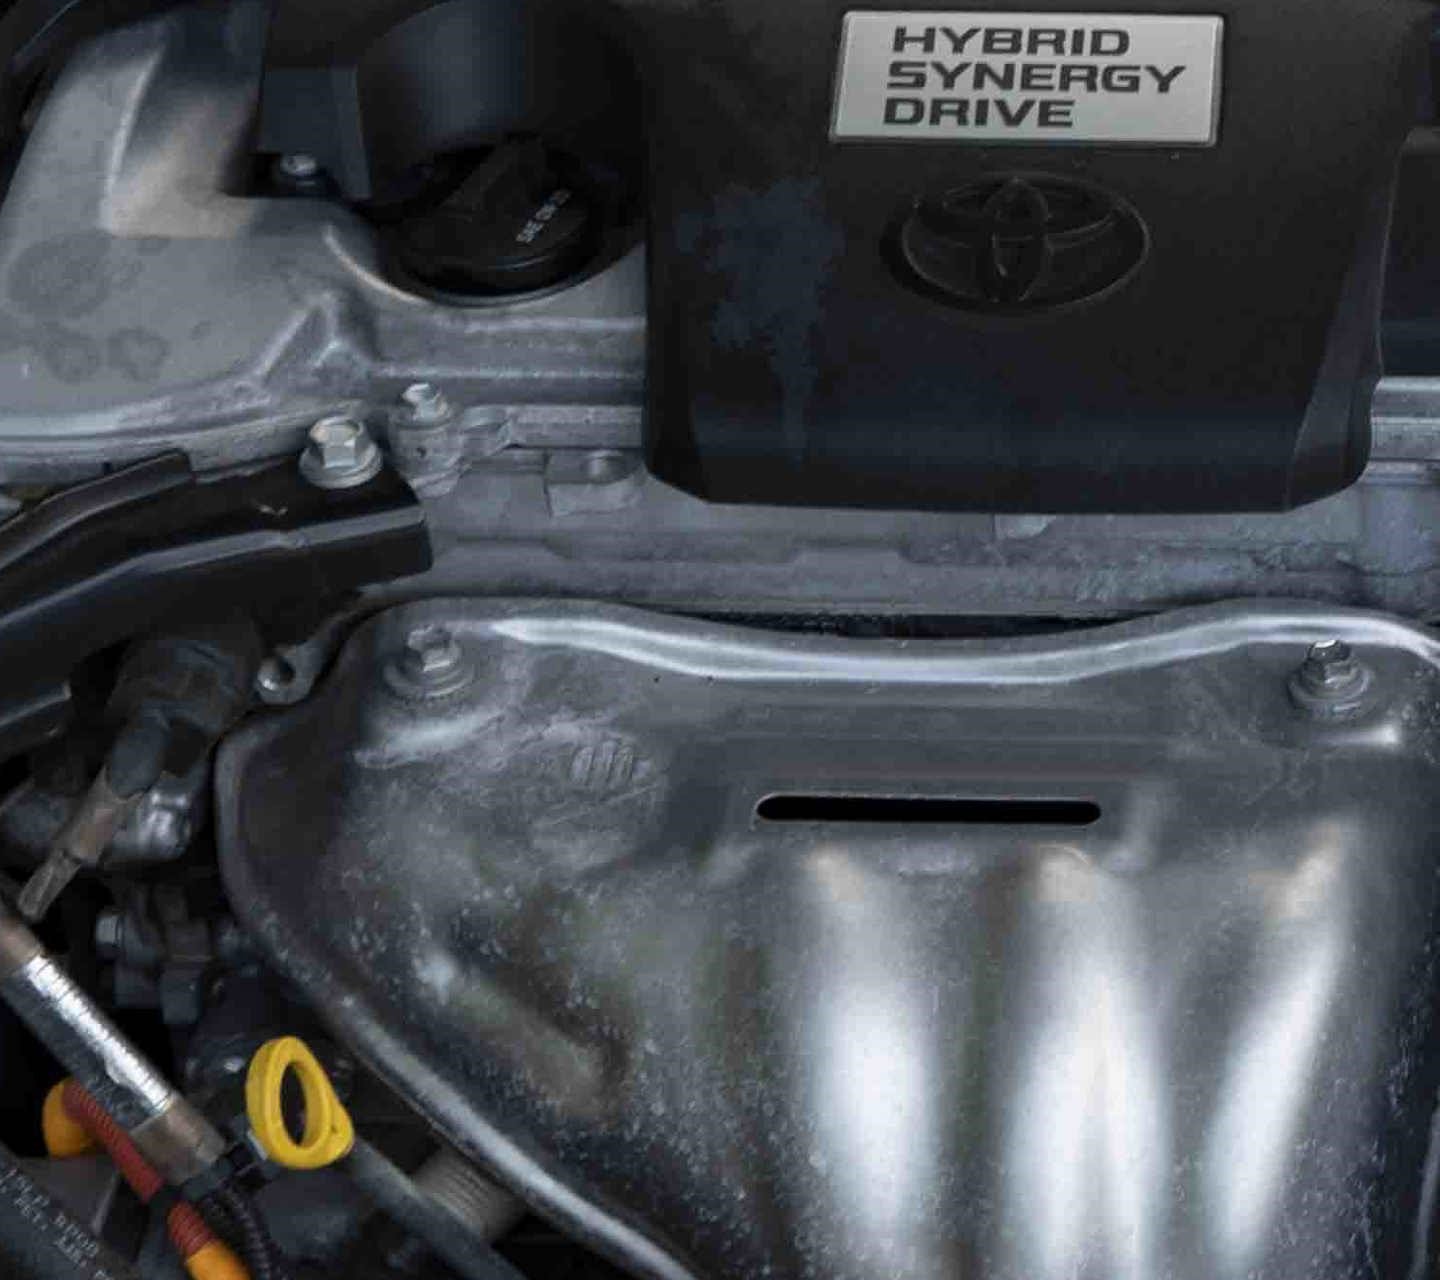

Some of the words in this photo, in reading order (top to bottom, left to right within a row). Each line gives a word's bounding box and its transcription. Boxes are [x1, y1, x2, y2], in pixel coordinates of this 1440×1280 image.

[892, 25, 1131, 57] HYBRID
[886, 60, 1187, 93] SYNERGY
[883, 97, 1076, 128] DRIVE
